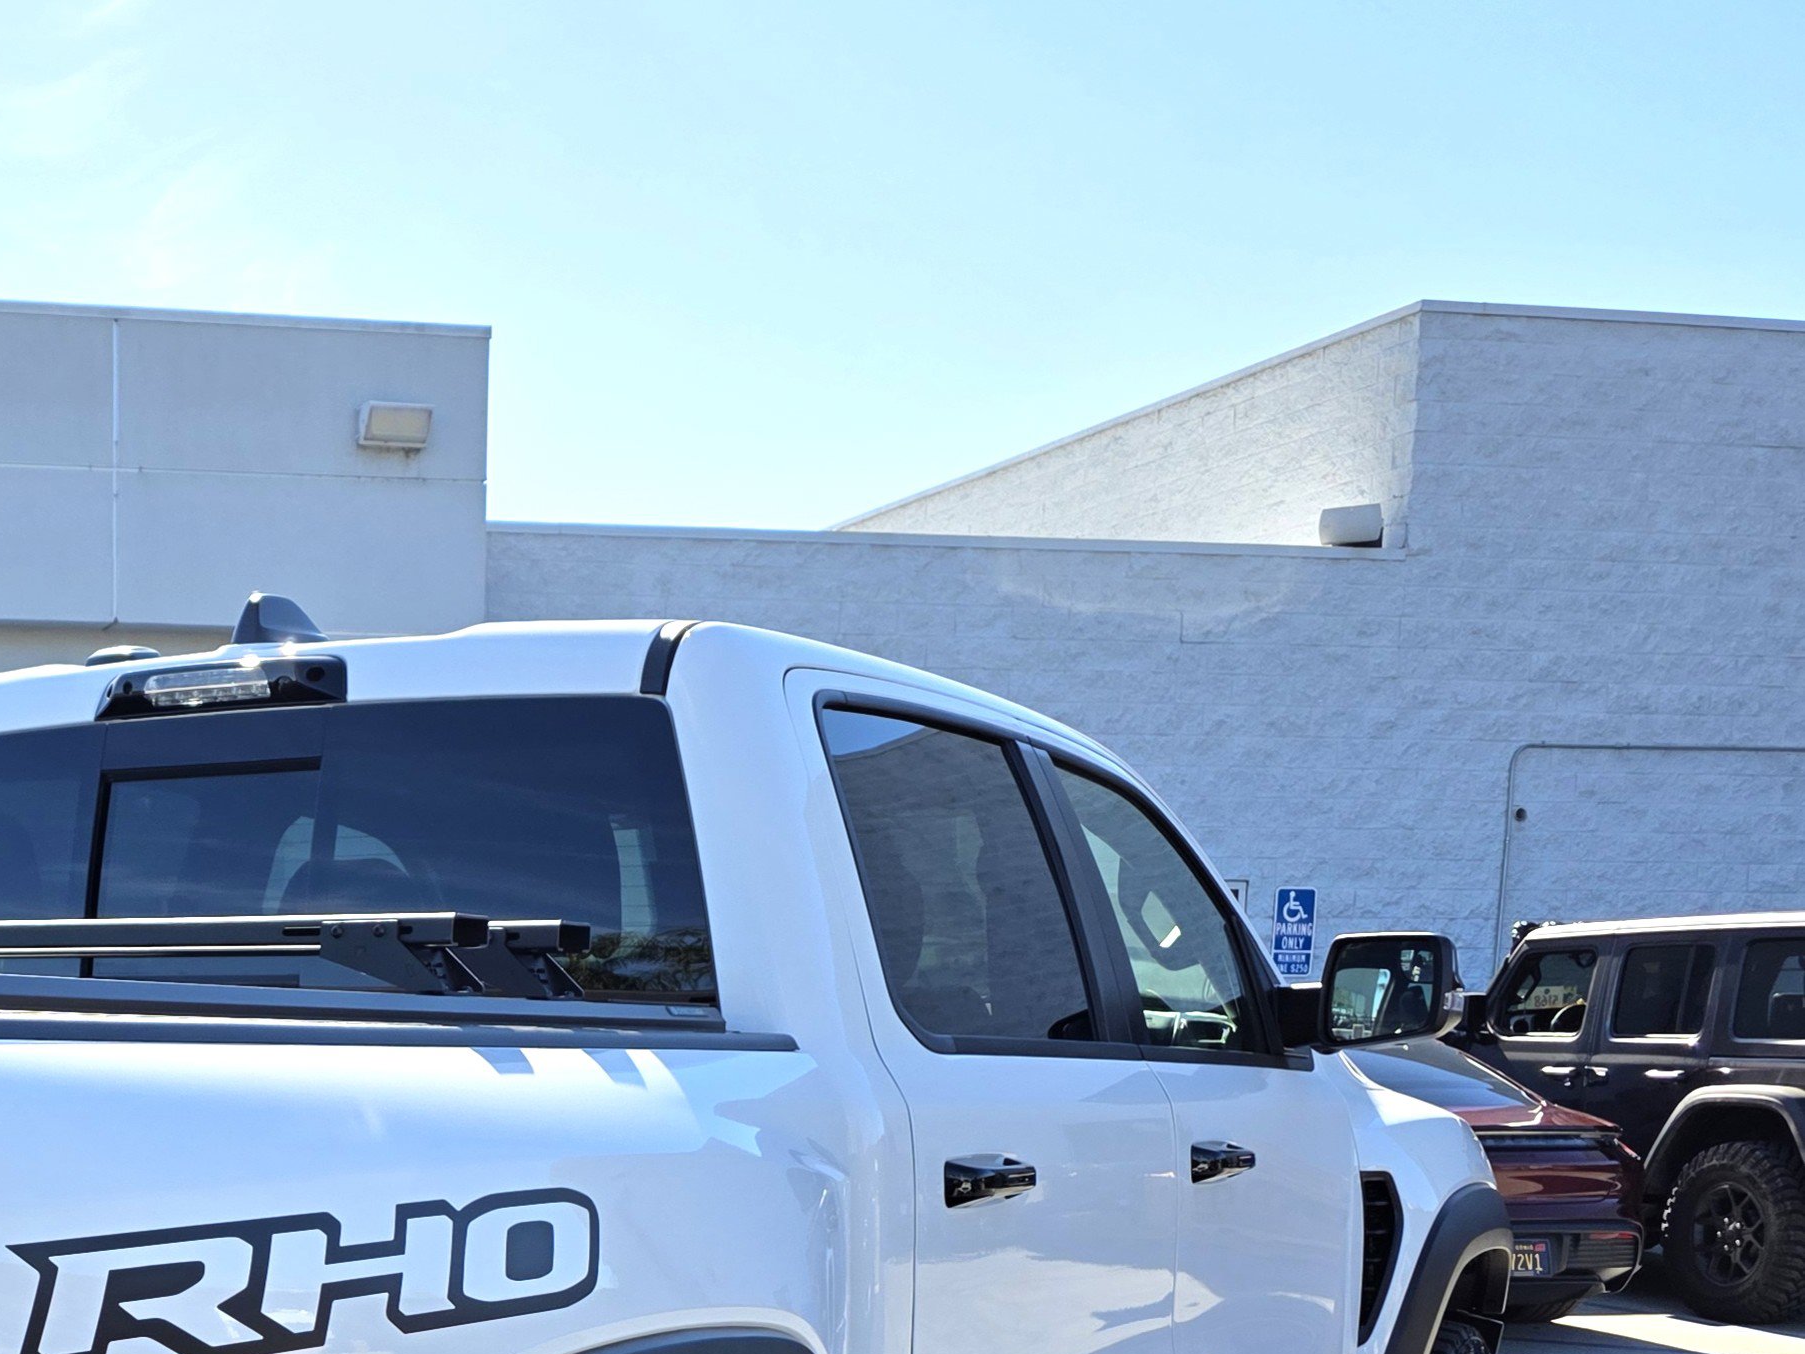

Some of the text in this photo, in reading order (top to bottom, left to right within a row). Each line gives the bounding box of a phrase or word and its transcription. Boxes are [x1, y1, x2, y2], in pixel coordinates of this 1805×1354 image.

[1275, 922, 1313, 936] PARKING
[1281, 936, 1305, 950] ONLY
[1277, 954, 1306, 963] MINIMUM
[1290, 963, 1308, 973] $250
[1511, 1253, 1544, 1273] 2V1
